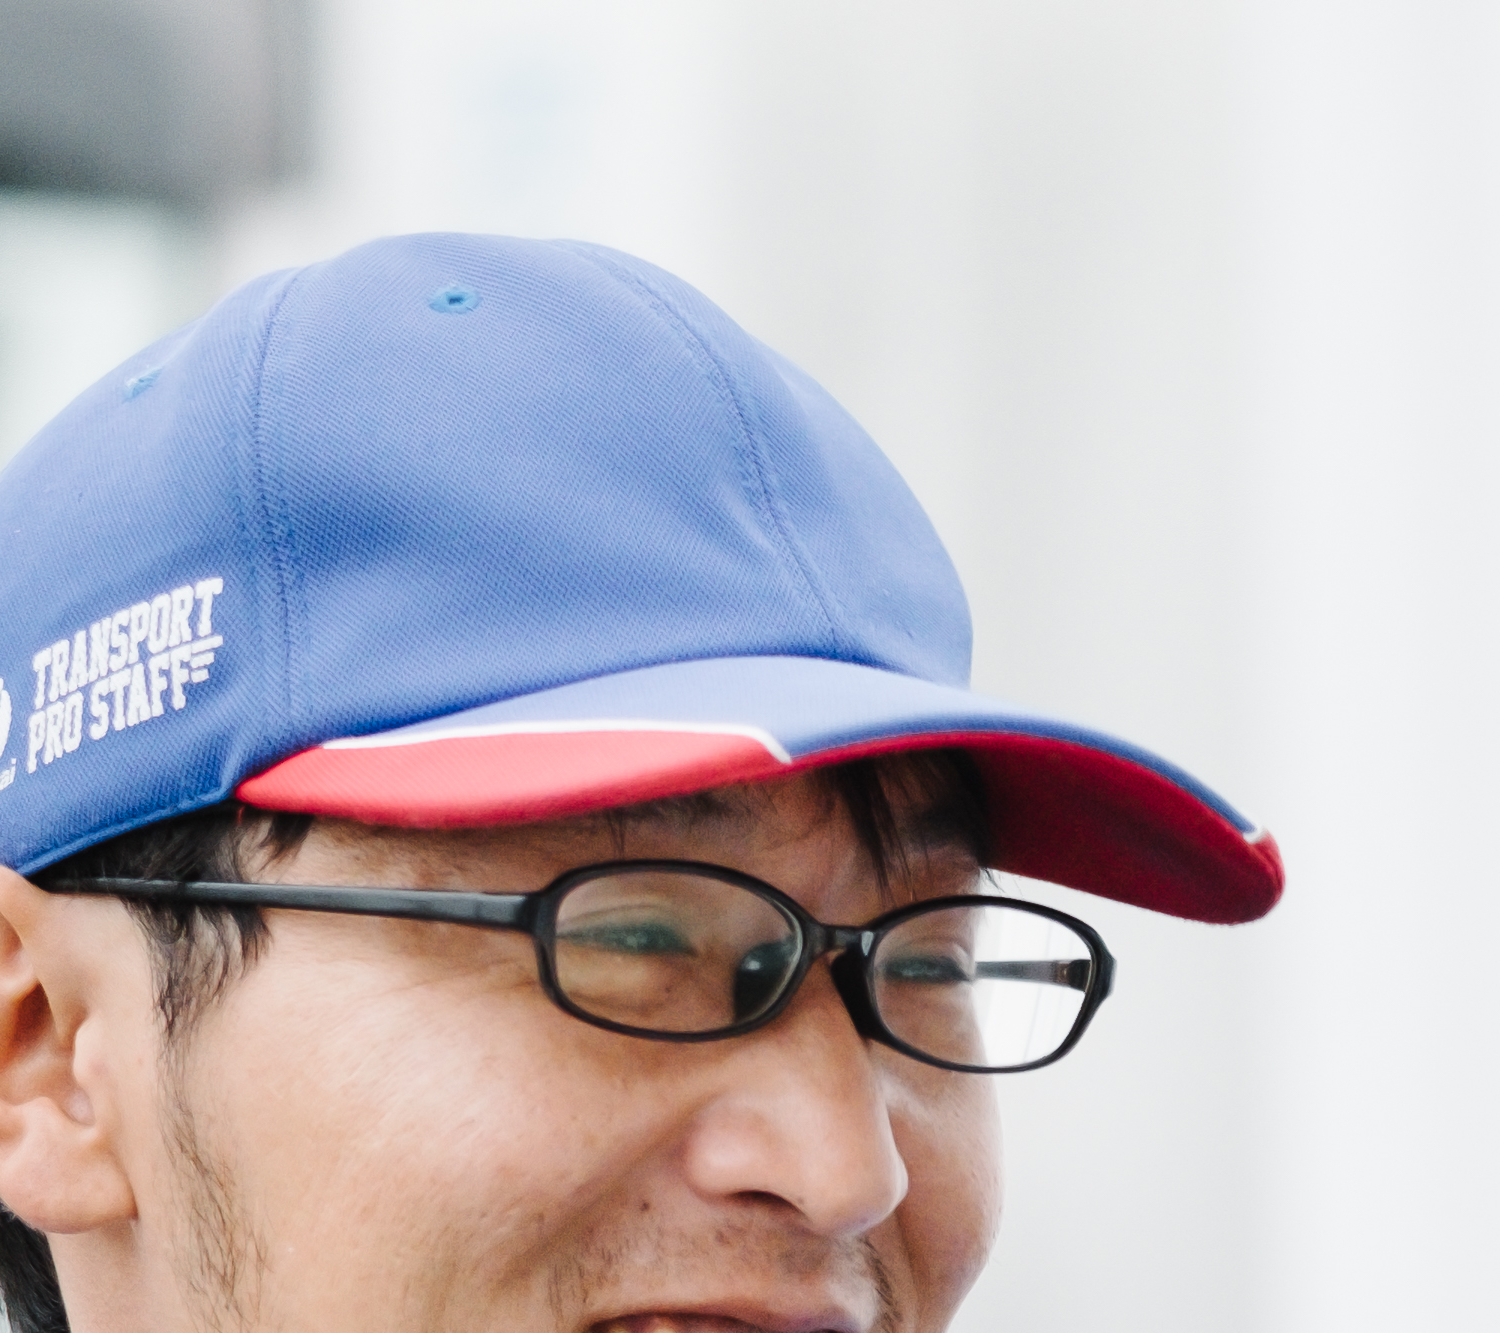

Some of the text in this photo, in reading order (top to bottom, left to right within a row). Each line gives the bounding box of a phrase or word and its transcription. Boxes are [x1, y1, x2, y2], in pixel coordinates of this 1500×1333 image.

[26, 642, 198, 773] PRO STAFF
[32, 576, 224, 709] TRANSPORT
